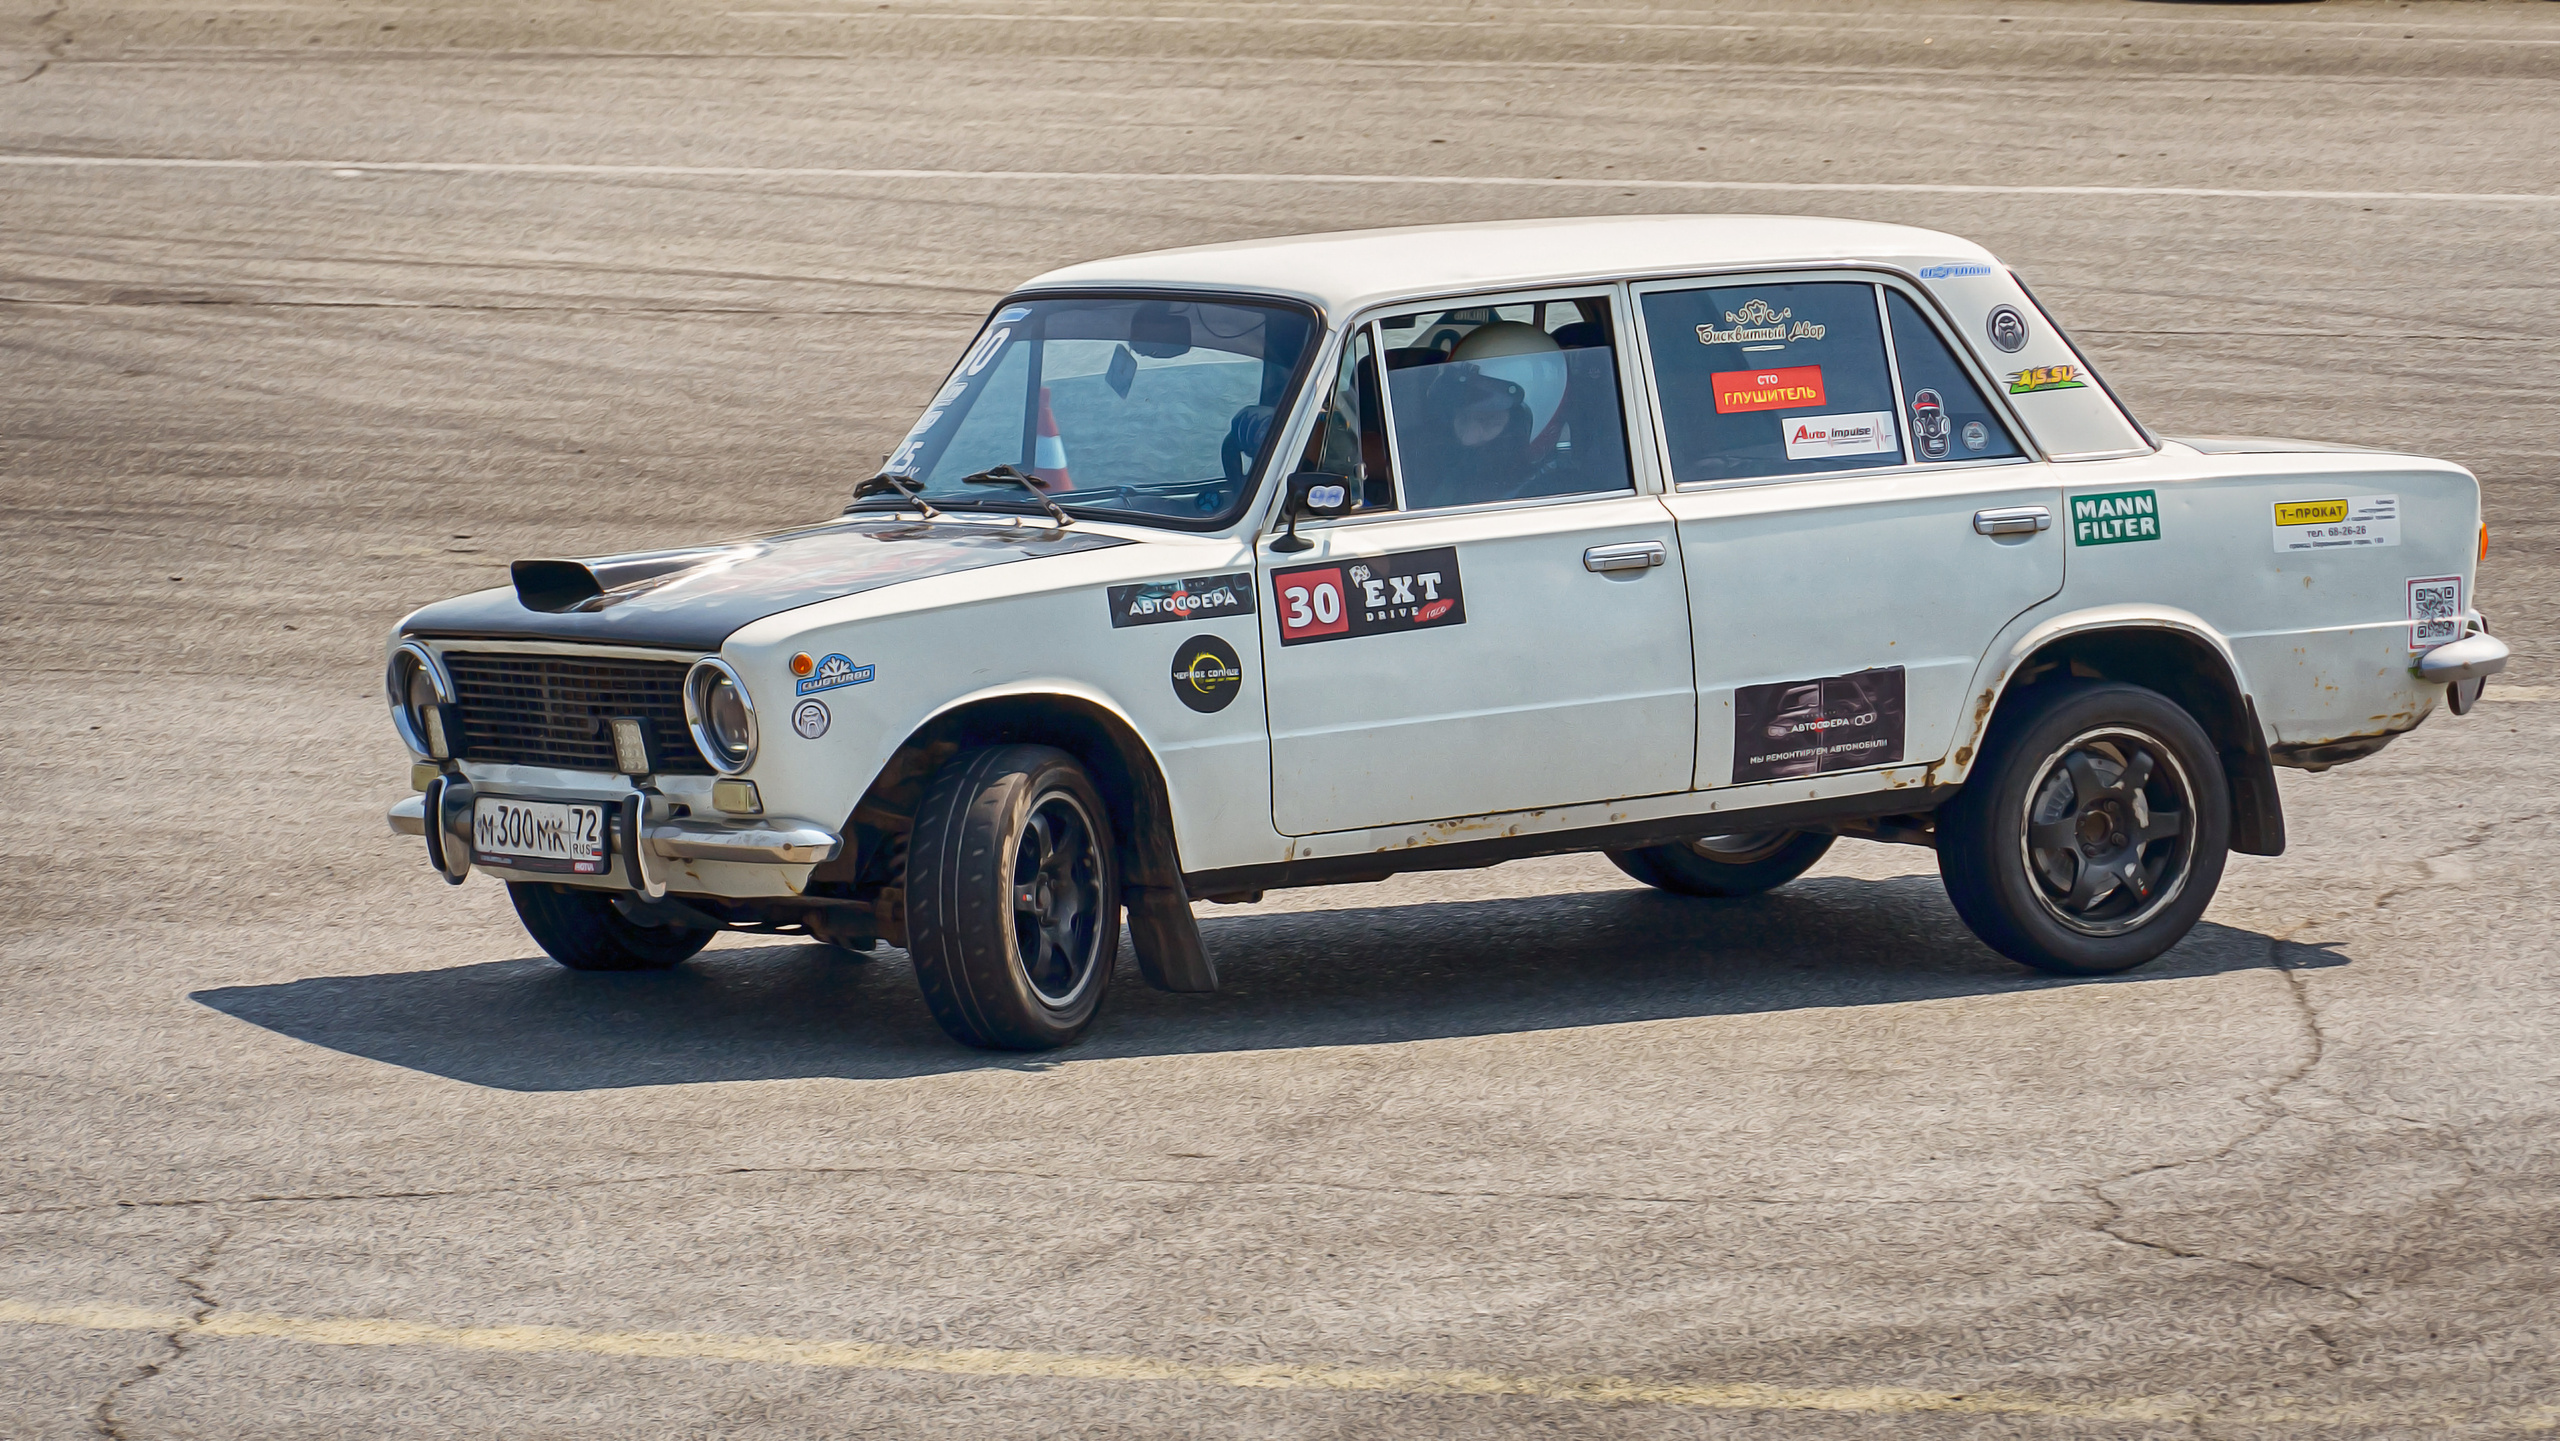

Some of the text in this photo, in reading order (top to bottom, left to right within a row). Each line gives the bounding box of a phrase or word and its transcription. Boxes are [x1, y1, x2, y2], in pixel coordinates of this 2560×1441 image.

[1696, 321, 1825, 344] Бисквитный Двор
[1757, 374, 1778, 386] СТО
[1725, 386, 1816, 405] ГЛУШИТЕЛЬ
[2075, 495, 2153, 519] MANN
[2280, 506, 2343, 520] Т-ПРОКАТ
[2078, 517, 2156, 541] FILTER
[2328, 525, 2367, 536] 68-26-26
[1362, 572, 1441, 608] EXT
[1129, 590, 1238, 616] АВТОСФЕРА
[1284, 583, 1340, 628] 30
[1366, 606, 1418, 622] DRIVE
[801, 669, 871, 692] CLUBTURBO
[1791, 718, 1850, 733] АВТОСФЕРА
[1750, 739, 1888, 765] МЫ РЕМОНТИРУЕМ АВТОМОБИЛИ
[572, 808, 597, 842] 72
[573, 843, 591, 855] RUS
